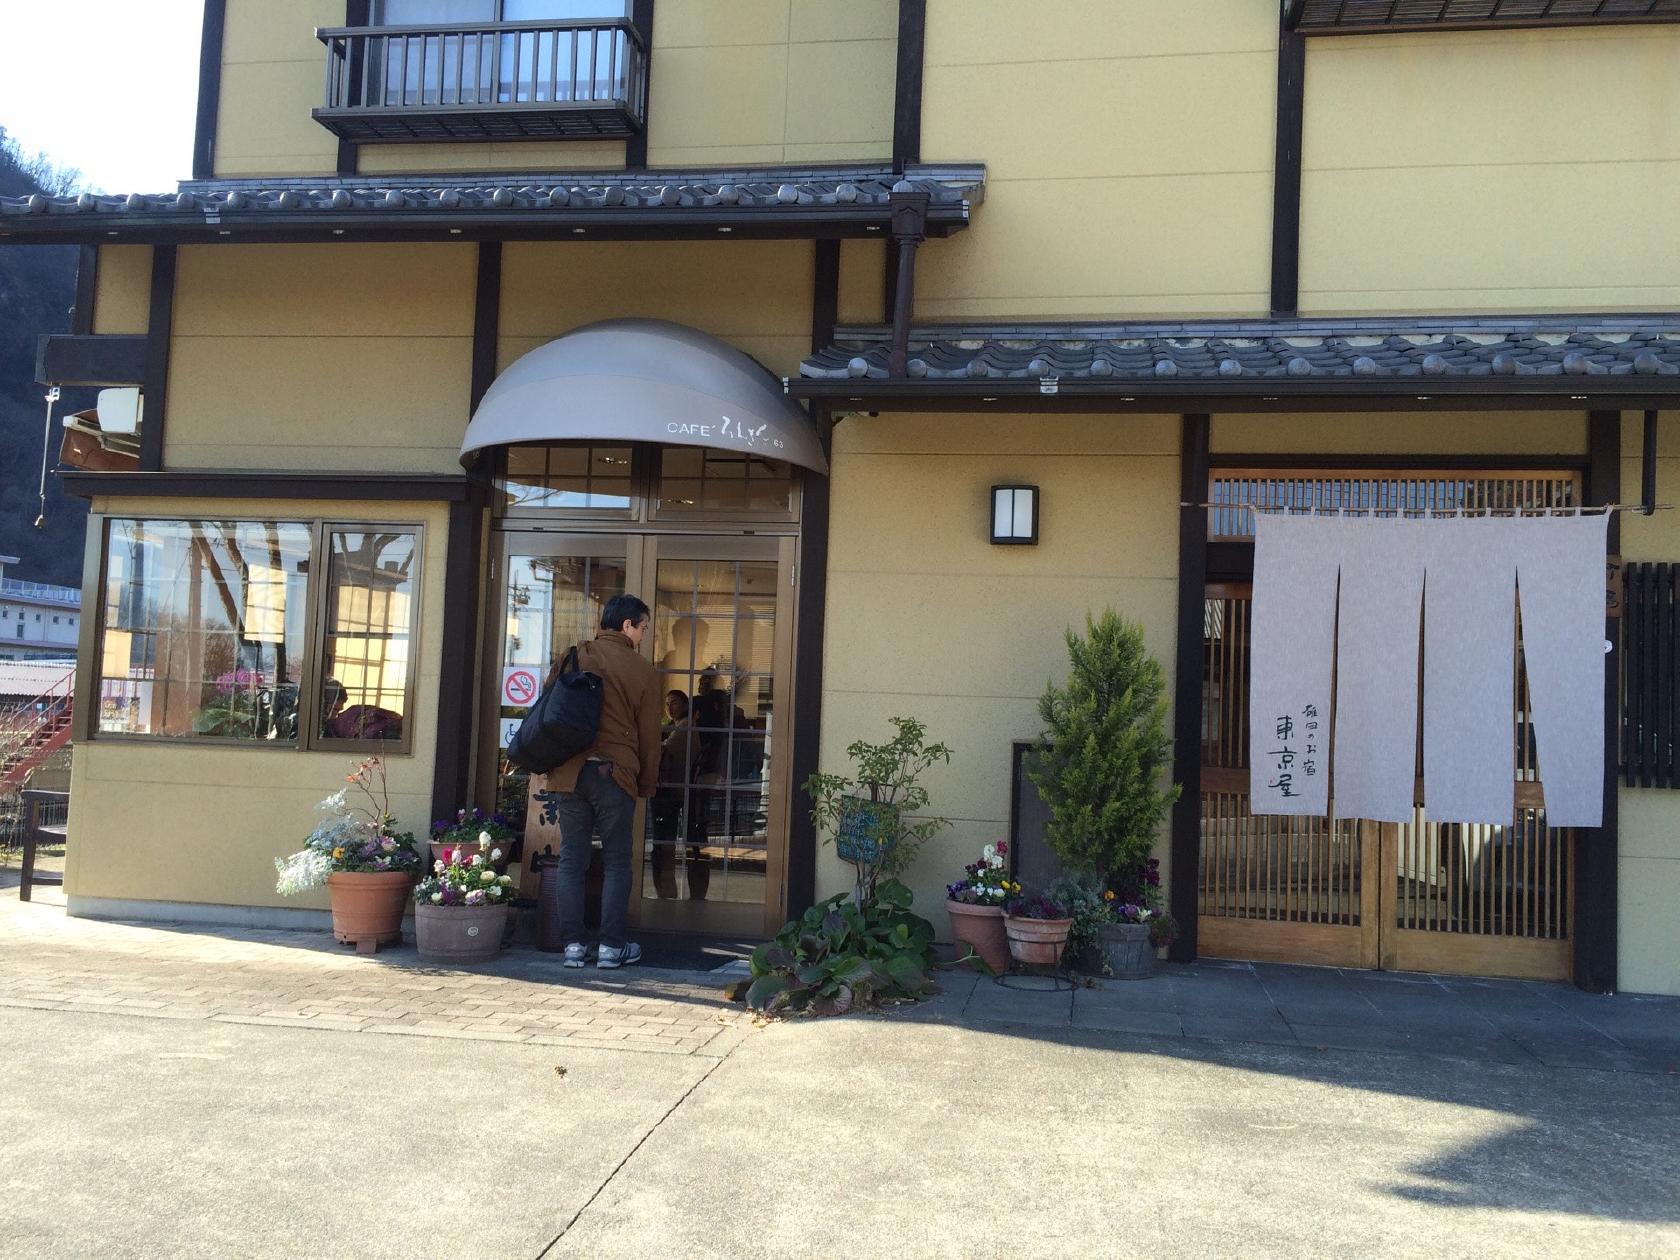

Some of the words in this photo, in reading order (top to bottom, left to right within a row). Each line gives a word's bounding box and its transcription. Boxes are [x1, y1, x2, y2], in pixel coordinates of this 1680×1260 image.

[773, 439, 784, 448] 63
[1267, 715, 1302, 797] 東京屋
